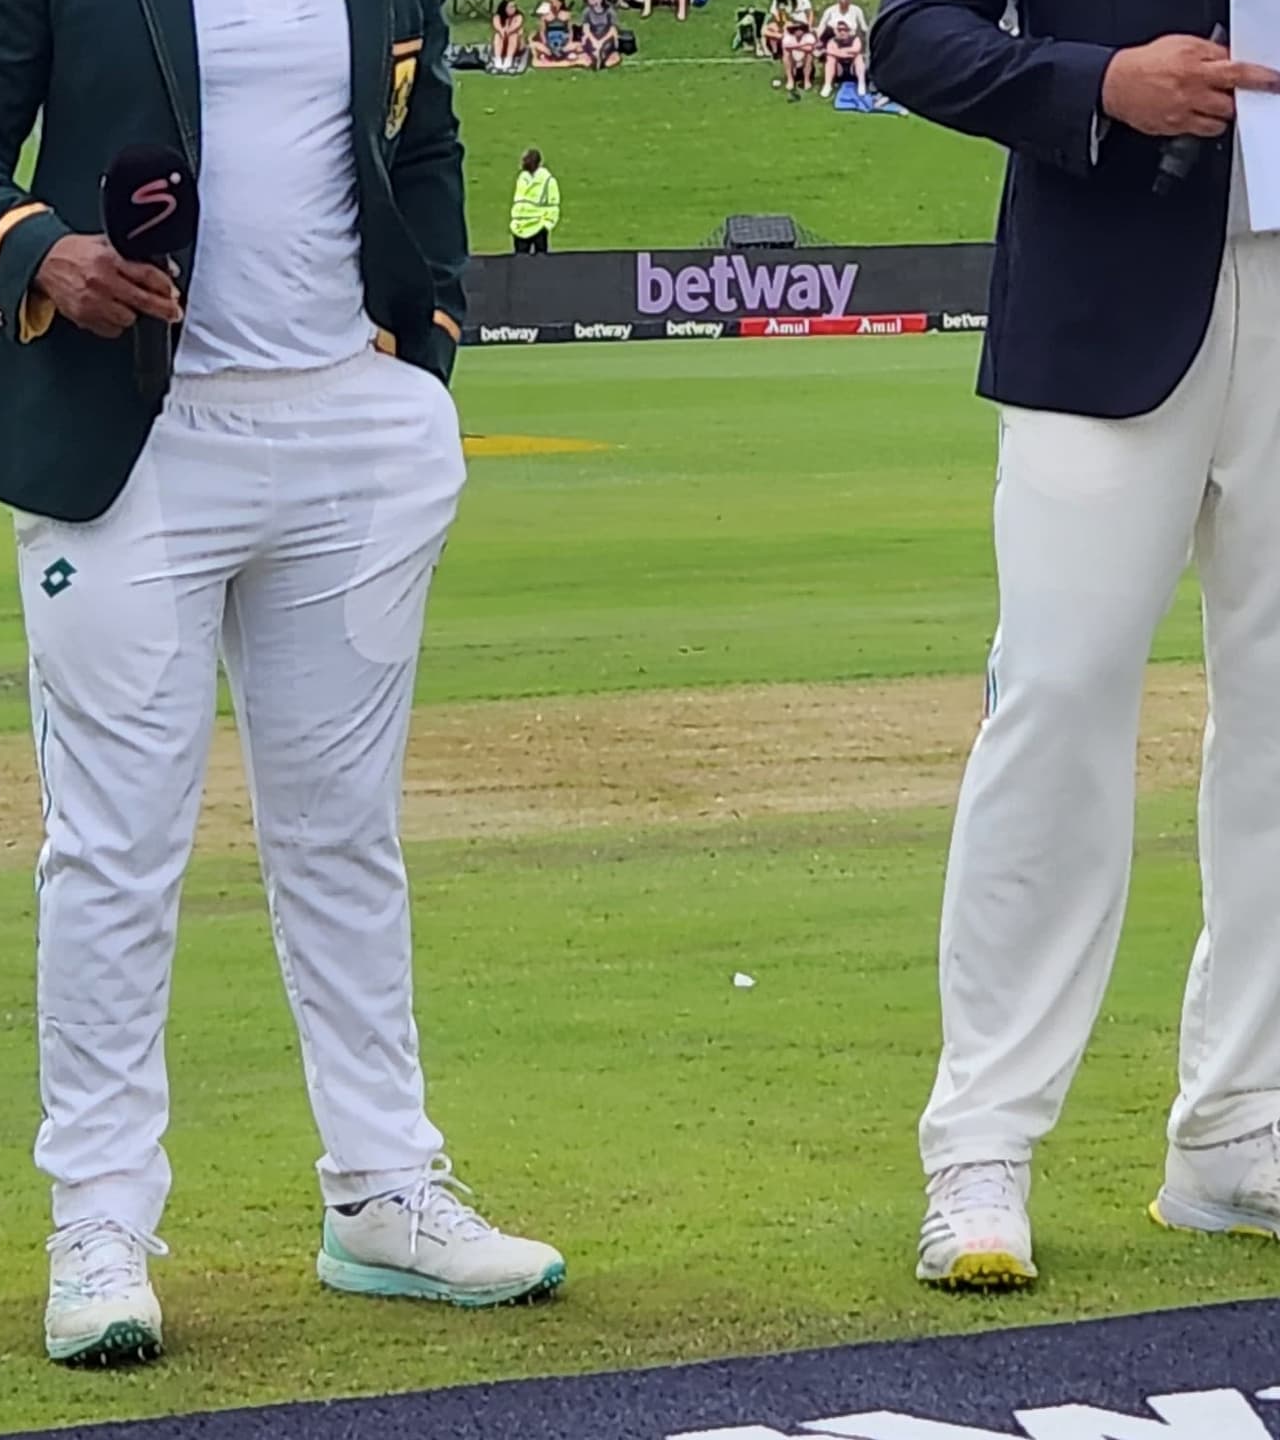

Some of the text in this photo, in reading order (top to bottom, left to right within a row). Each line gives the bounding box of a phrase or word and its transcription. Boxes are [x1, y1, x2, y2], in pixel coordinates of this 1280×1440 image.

[637, 252, 858, 318] betway
[764, 318, 810, 334] Amul
[857, 318, 902, 334] Amul
[943, 312, 988, 329] betwa
[480, 326, 539, 343] betway
[574, 323, 632, 340] betway
[667, 320, 724, 339] betway
